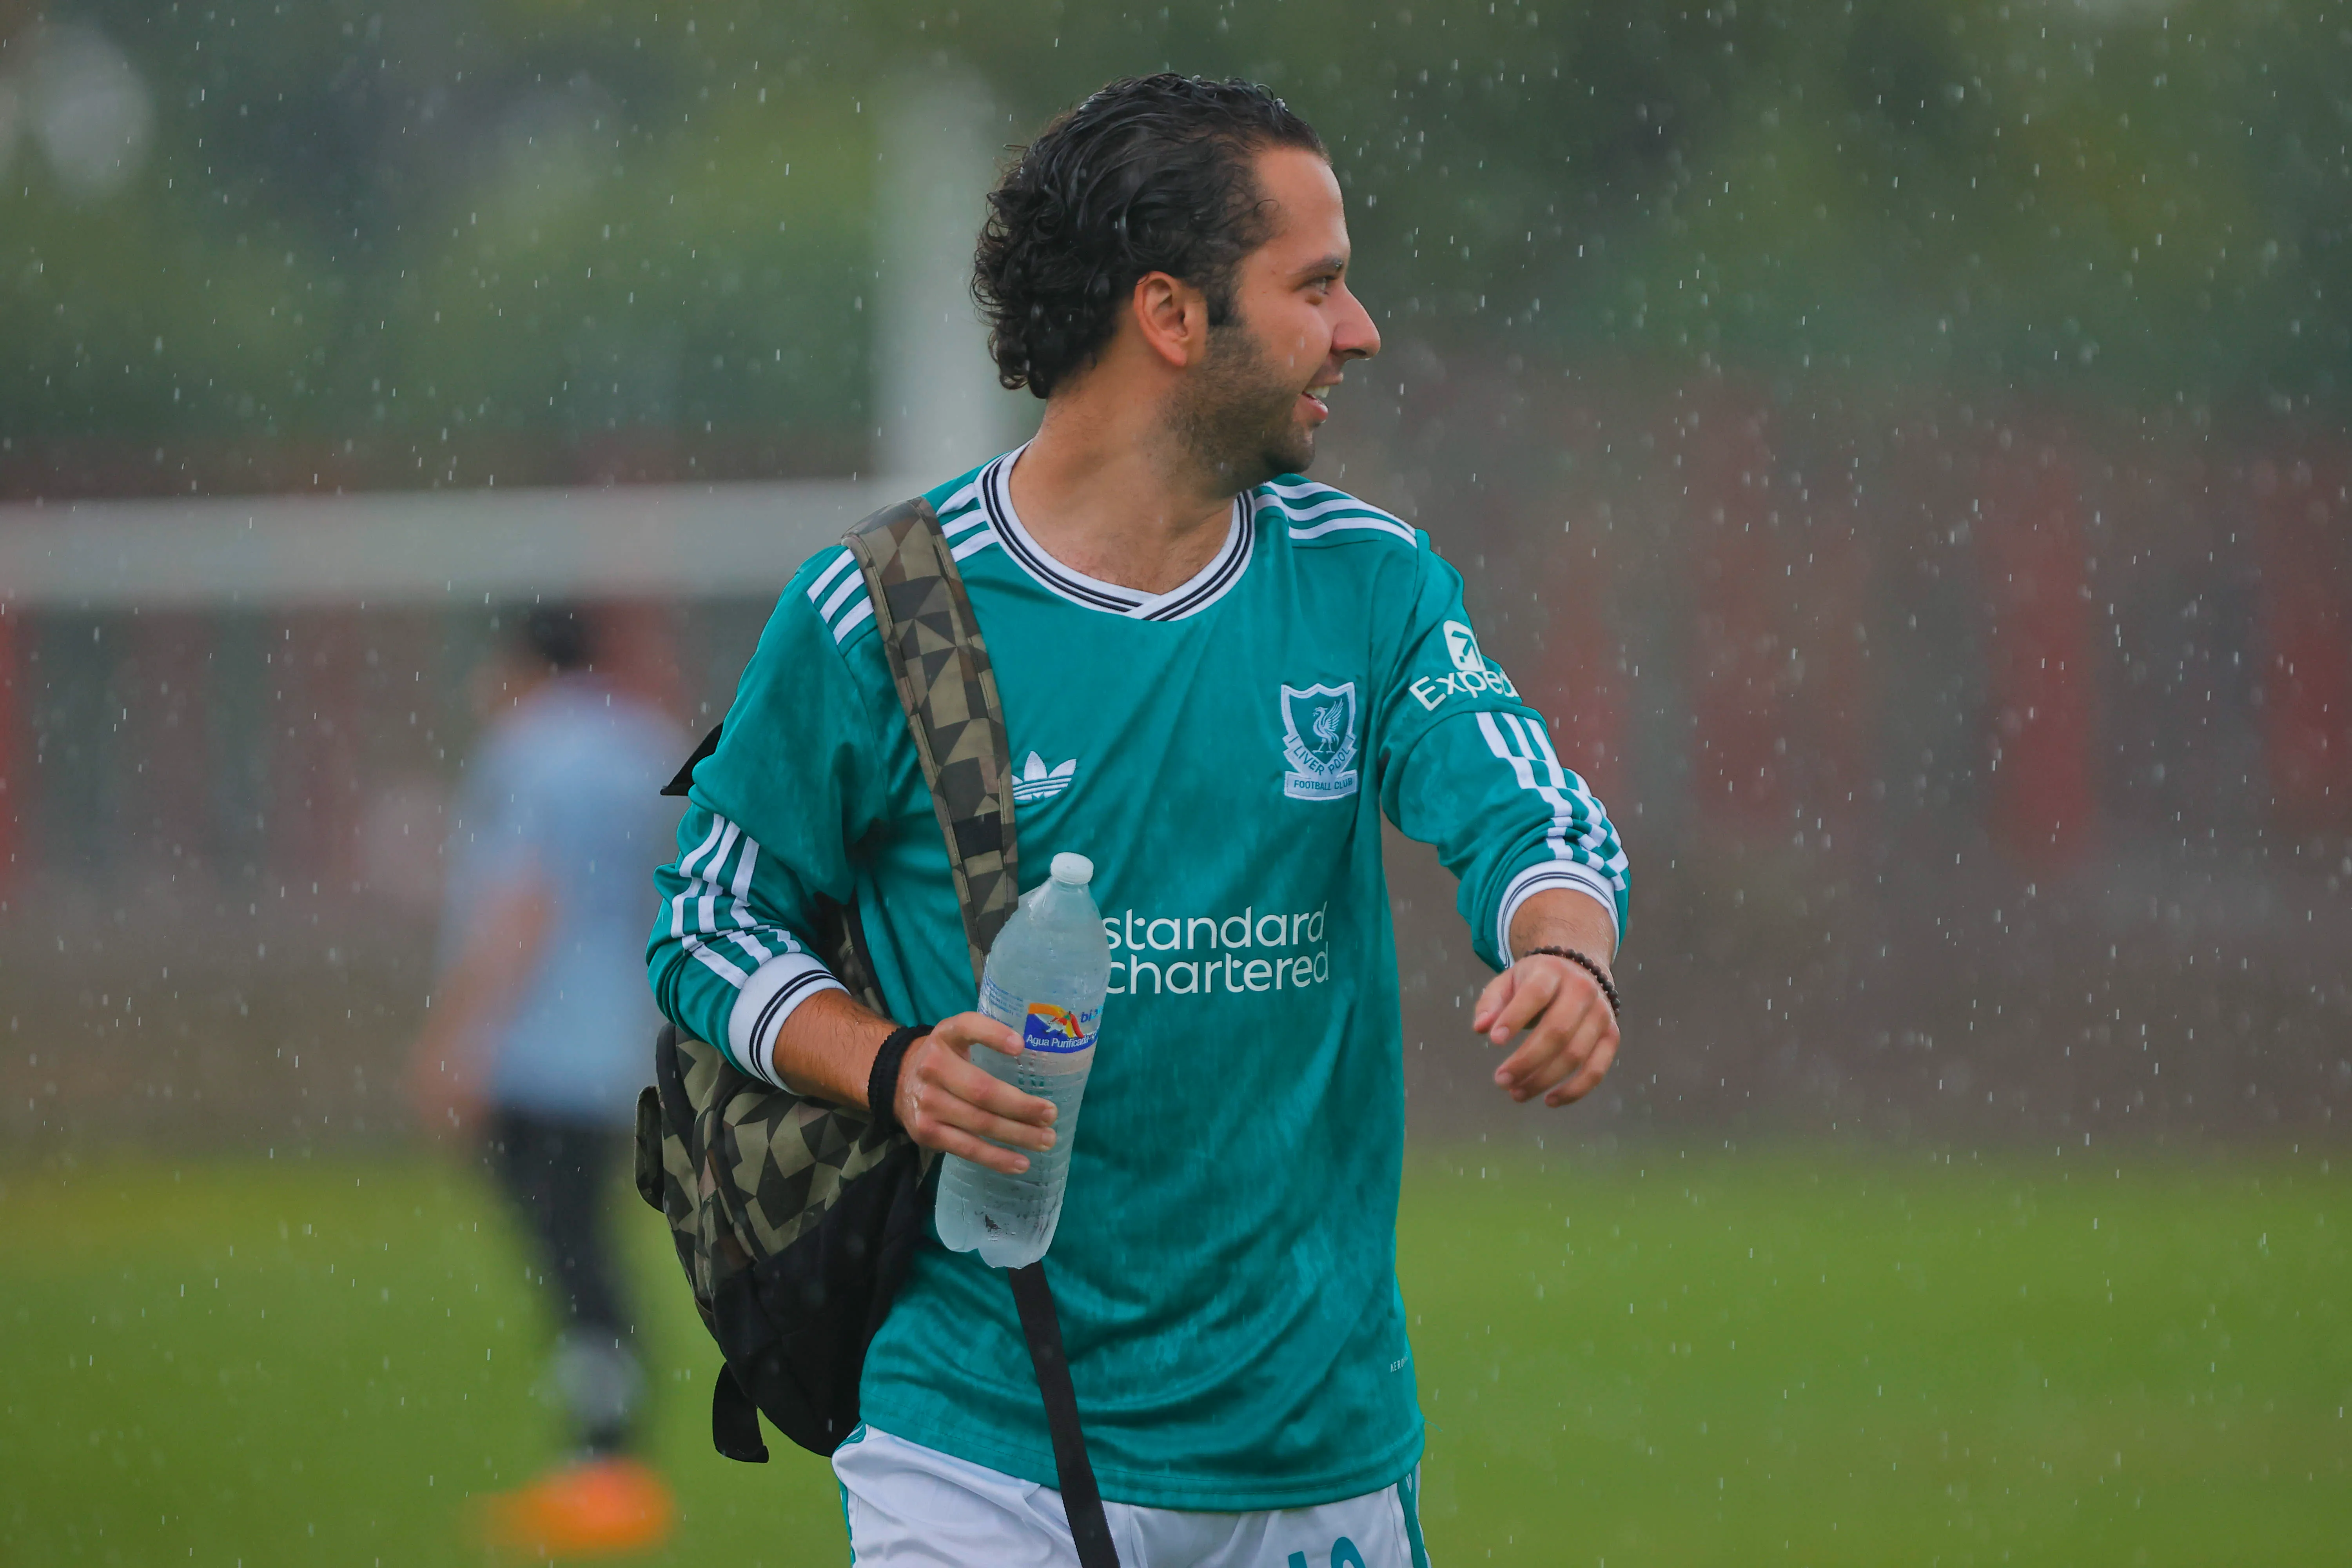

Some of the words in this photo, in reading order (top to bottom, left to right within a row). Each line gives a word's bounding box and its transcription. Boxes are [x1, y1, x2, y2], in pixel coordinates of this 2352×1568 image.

[1294, 780, 1332, 790] FOOTBALL
[1334, 777, 1353, 789] CLUB
[1102, 901, 1328, 950] standard
[1026, 1034, 1049, 1047] Agua
[1051, 1034, 1089, 1048] Purificada
